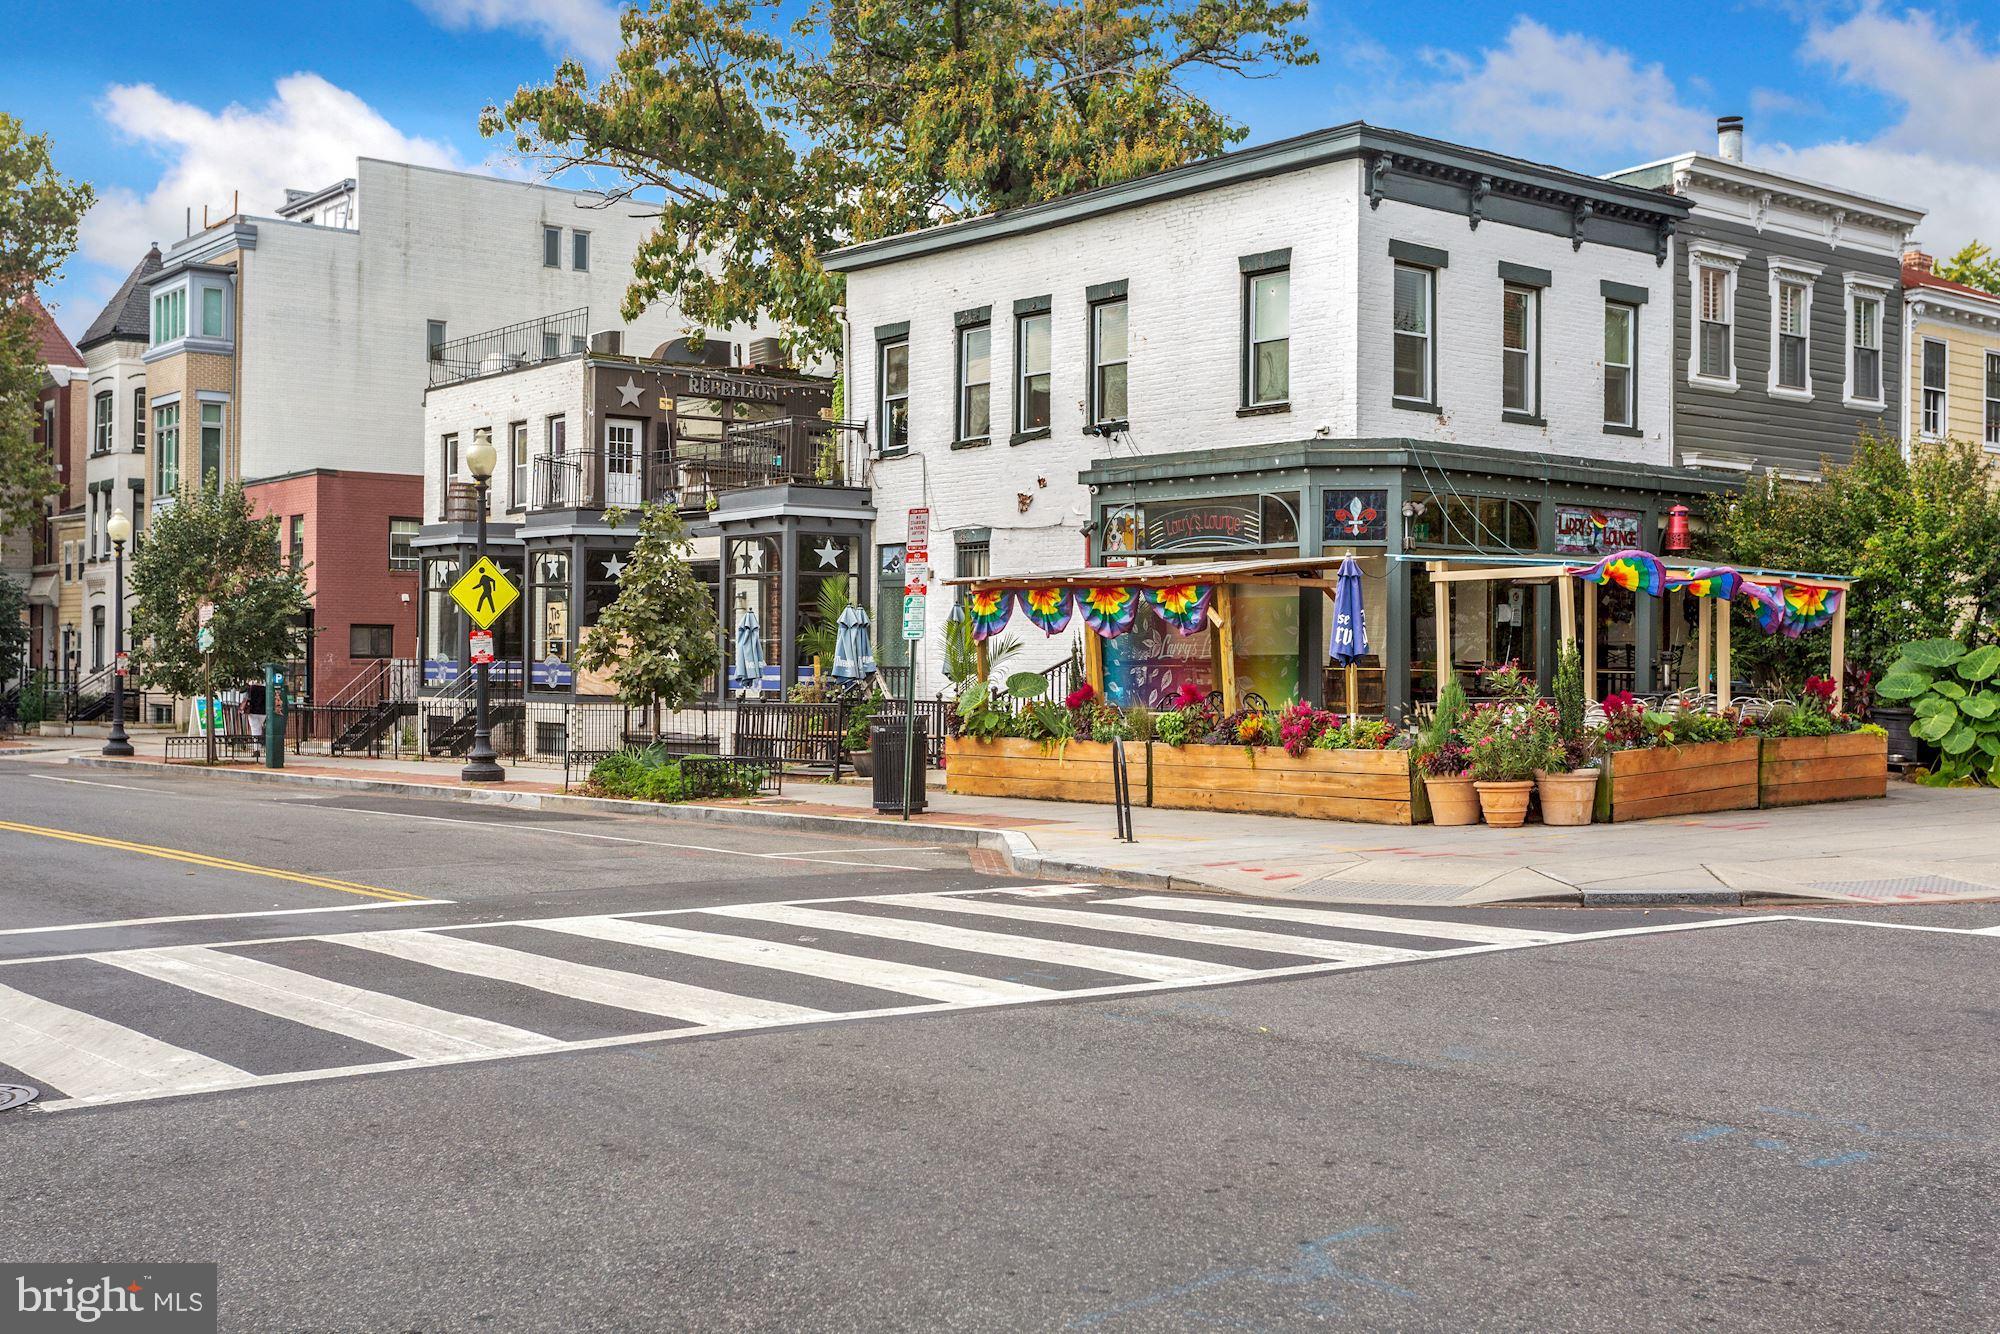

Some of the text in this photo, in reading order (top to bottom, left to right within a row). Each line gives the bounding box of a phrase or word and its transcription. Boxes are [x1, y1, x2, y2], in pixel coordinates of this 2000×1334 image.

[688, 377, 778, 401] REBELLION
[1204, 512, 1241, 536] Lounge
[1602, 526, 1637, 546] LOUNGE
[1158, 634, 1198, 663] Larry's
